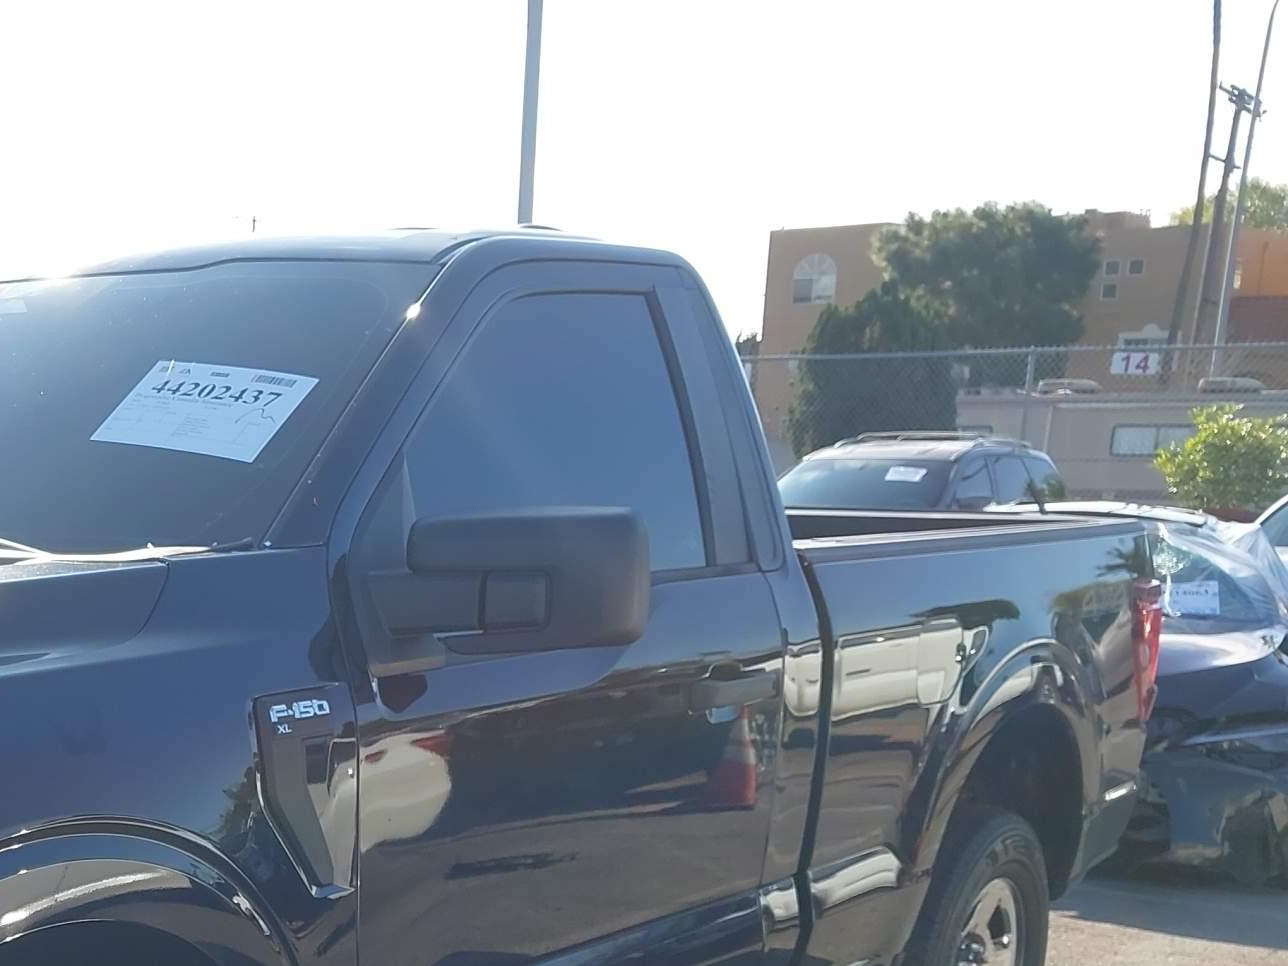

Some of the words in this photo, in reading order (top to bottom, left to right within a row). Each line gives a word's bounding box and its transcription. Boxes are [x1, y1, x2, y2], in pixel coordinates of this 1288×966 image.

[1121, 352, 1150, 374] 14
[151, 379, 284, 408] 44202437
[269, 699, 330, 722] F-150
[277, 723, 292, 734] XL
